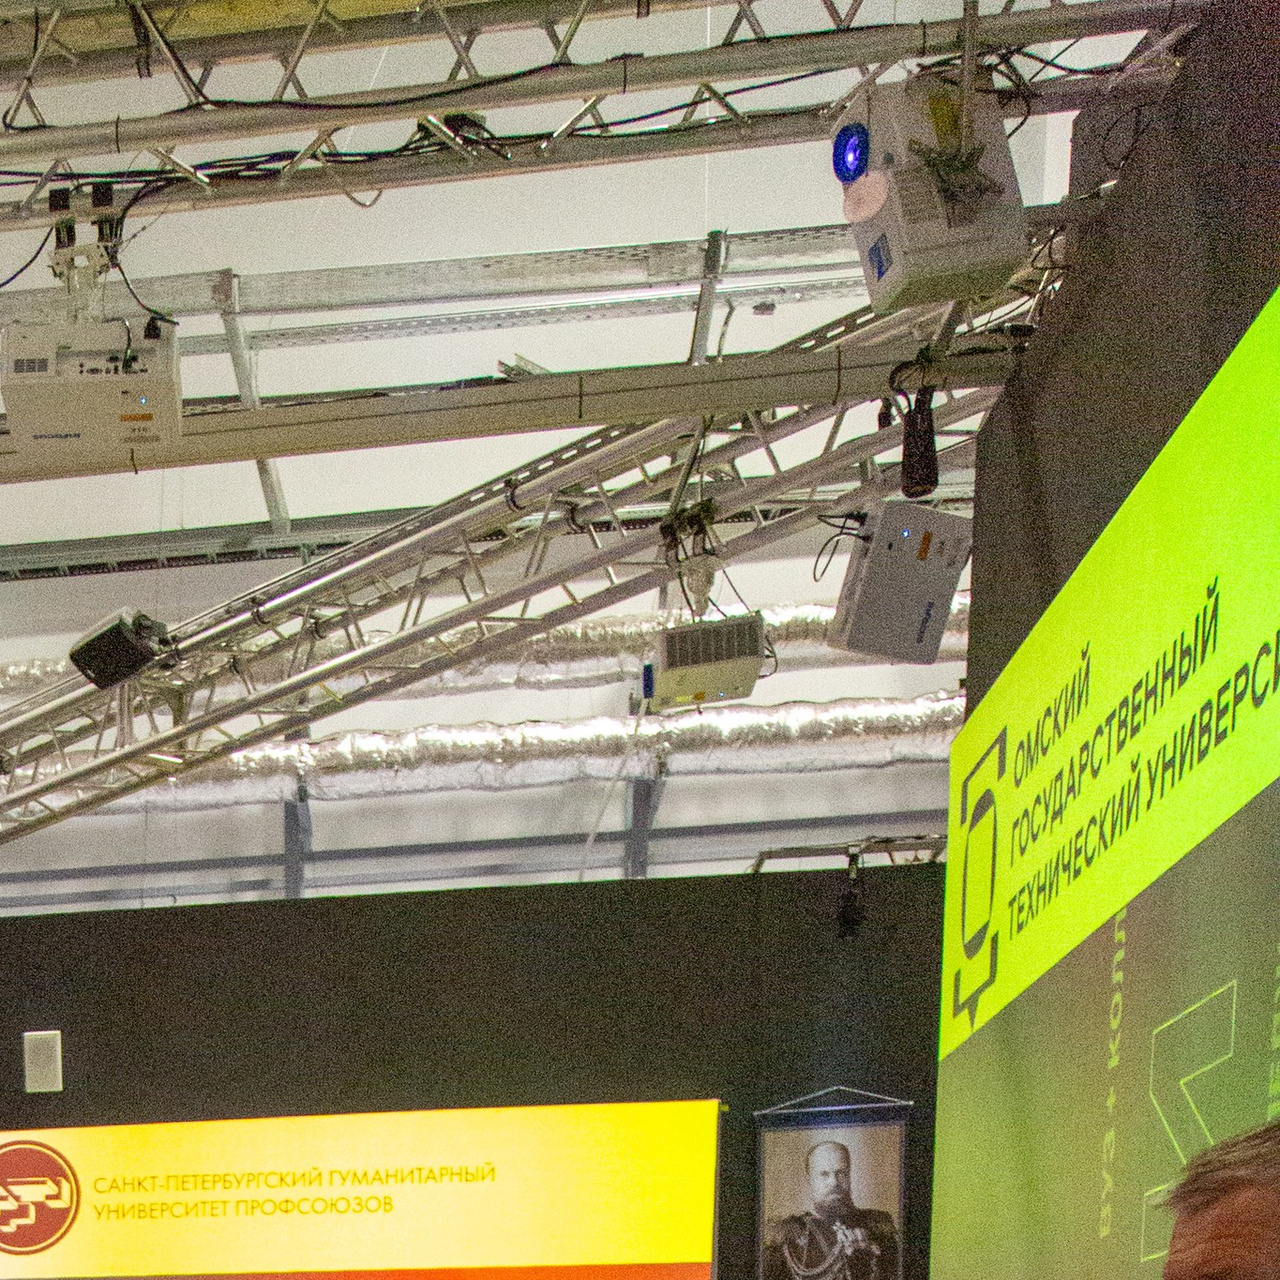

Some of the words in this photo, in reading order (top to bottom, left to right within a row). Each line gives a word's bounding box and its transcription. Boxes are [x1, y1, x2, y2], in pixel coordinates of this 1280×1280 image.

[1010, 575, 1220, 869] ГОСУДАРСТВЕННЫЙ
[1013, 640, 1092, 789] ОМСКИЙ
[1008, 752, 1142, 941] ТЕХНИЧЕСКИЙ
[93, 1167, 323, 1194] САНКТ-ПЕТЕРБУРГСКИЙ
[329, 1162, 496, 1188] ГУМАНИТАРНЫЙ
[94, 1200, 230, 1221] УНИВЕРСИТЕТ
[235, 1196, 394, 1217] ПРОФСОЮЗОВ
